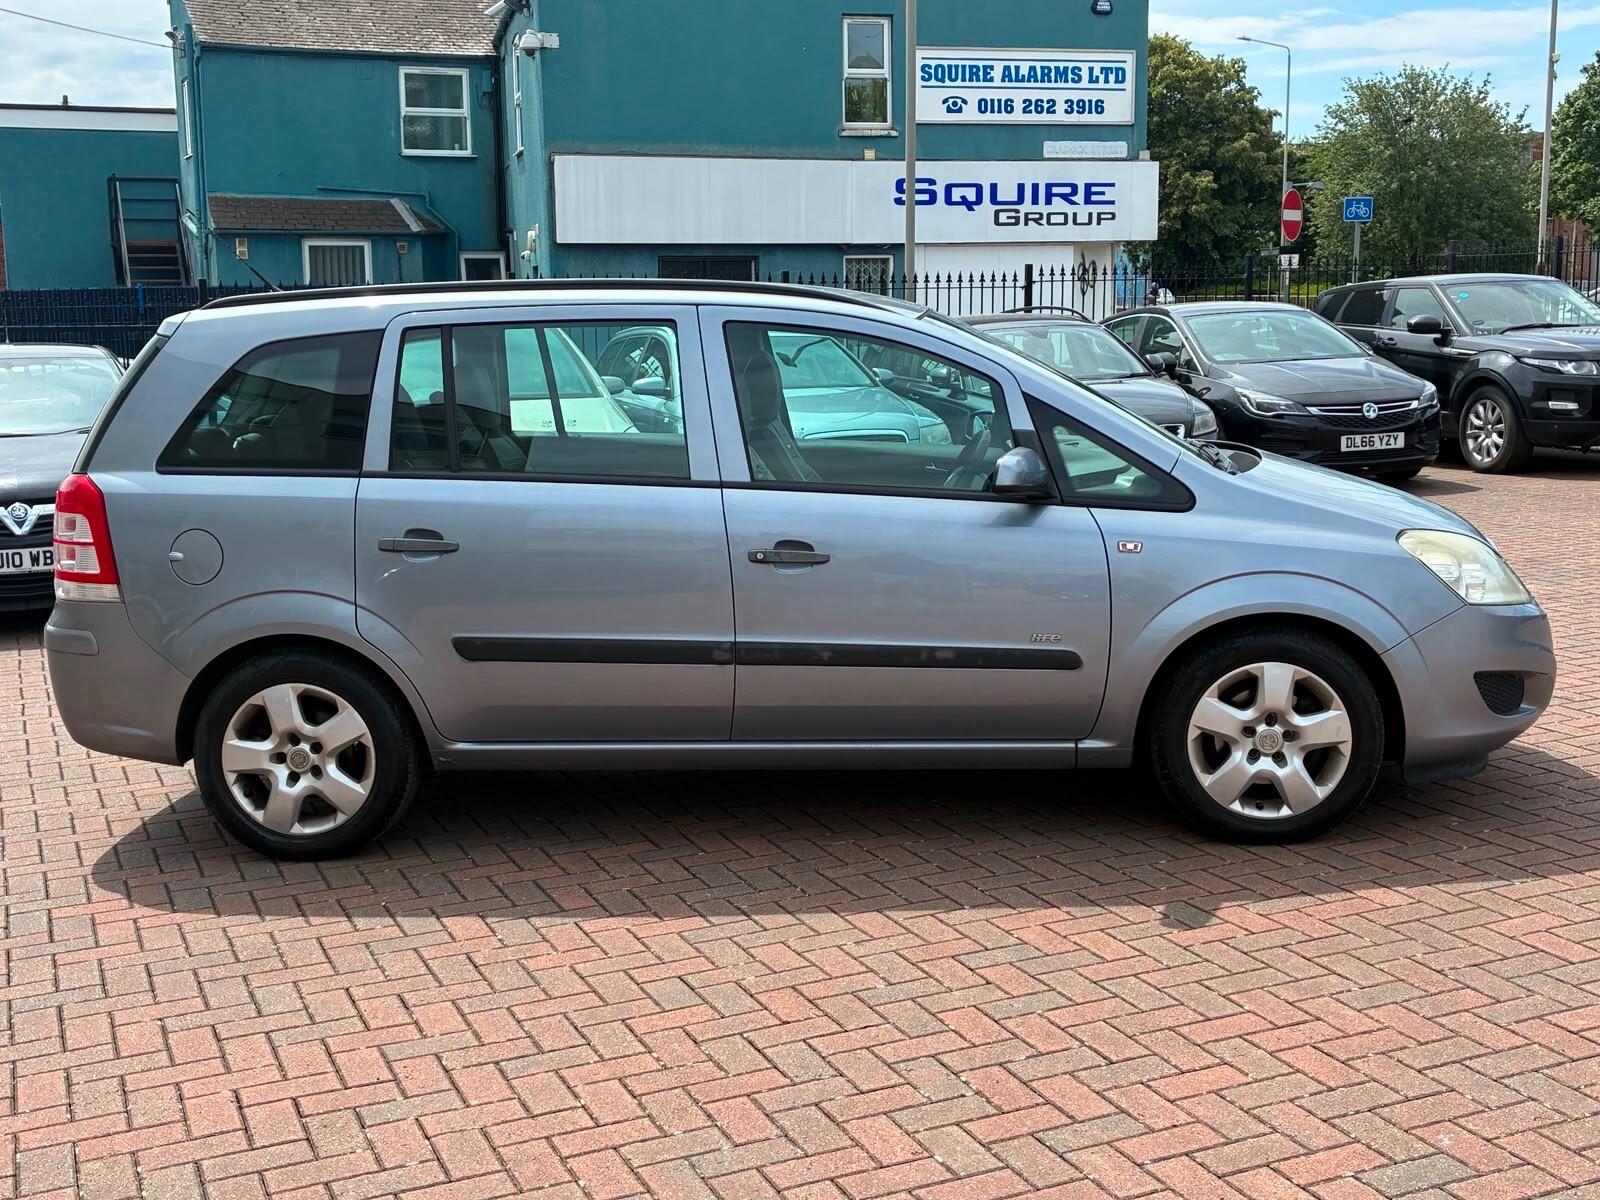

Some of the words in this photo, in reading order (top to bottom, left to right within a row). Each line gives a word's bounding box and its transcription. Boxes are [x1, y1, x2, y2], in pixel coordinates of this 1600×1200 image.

[920, 63, 995, 84] SQUIRE
[1000, 65, 1083, 84] ALARMS
[1087, 66, 1127, 84] LTD
[977, 98, 1015, 114] 0116
[1022, 98, 1057, 115] 262
[1063, 99, 1105, 115] 3916
[893, 177, 1116, 212] SQUIRE
[993, 208, 1116, 227] GROUP
[1345, 436, 1375, 449] DL66
[1378, 434, 1399, 447] YZY
